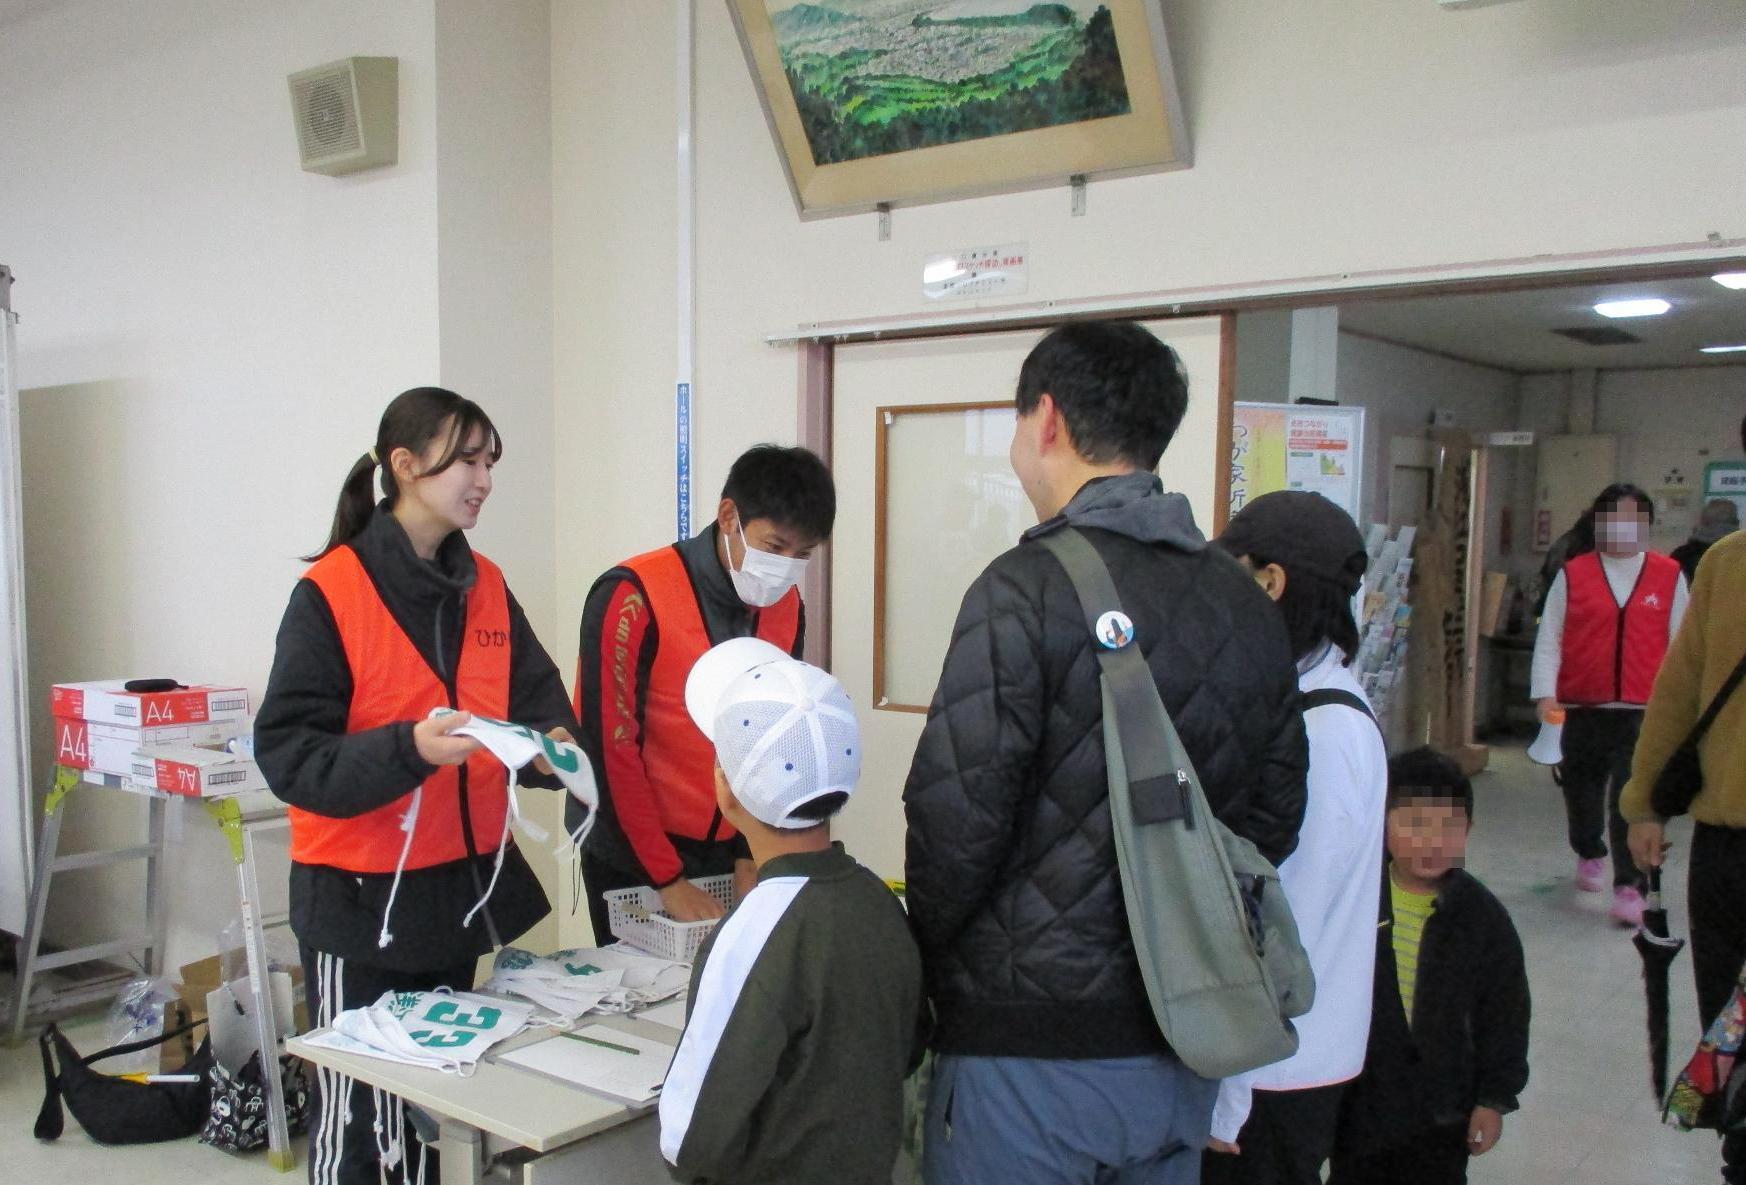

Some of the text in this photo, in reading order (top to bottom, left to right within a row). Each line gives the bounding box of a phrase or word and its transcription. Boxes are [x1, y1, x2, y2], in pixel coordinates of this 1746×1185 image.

[146, 700, 174, 724] A4
[59, 724, 87, 763] A4
[177, 767, 197, 792] A4
